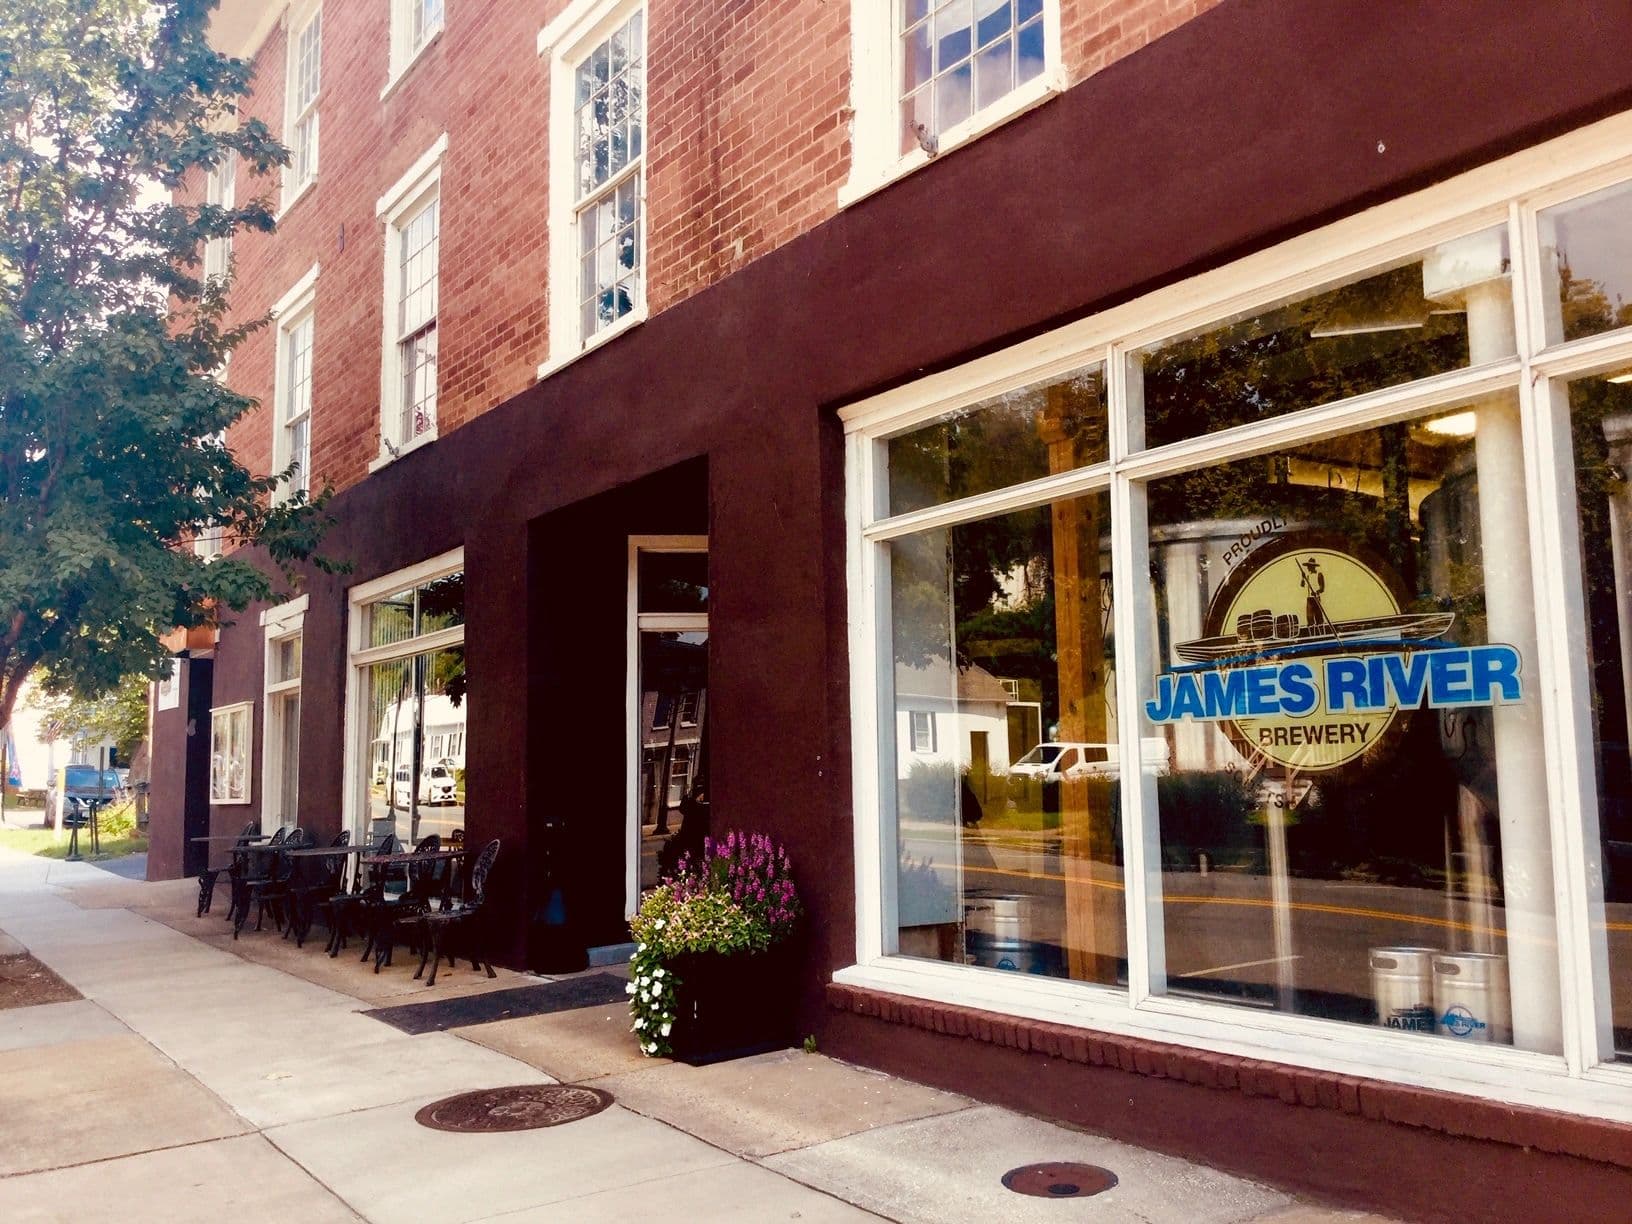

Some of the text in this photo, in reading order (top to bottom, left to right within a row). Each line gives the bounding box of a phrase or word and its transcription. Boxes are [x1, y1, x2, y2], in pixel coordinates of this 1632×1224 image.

[1145, 646, 1521, 721] JAMES RIVER
[1259, 722, 1371, 746] BREWERY
